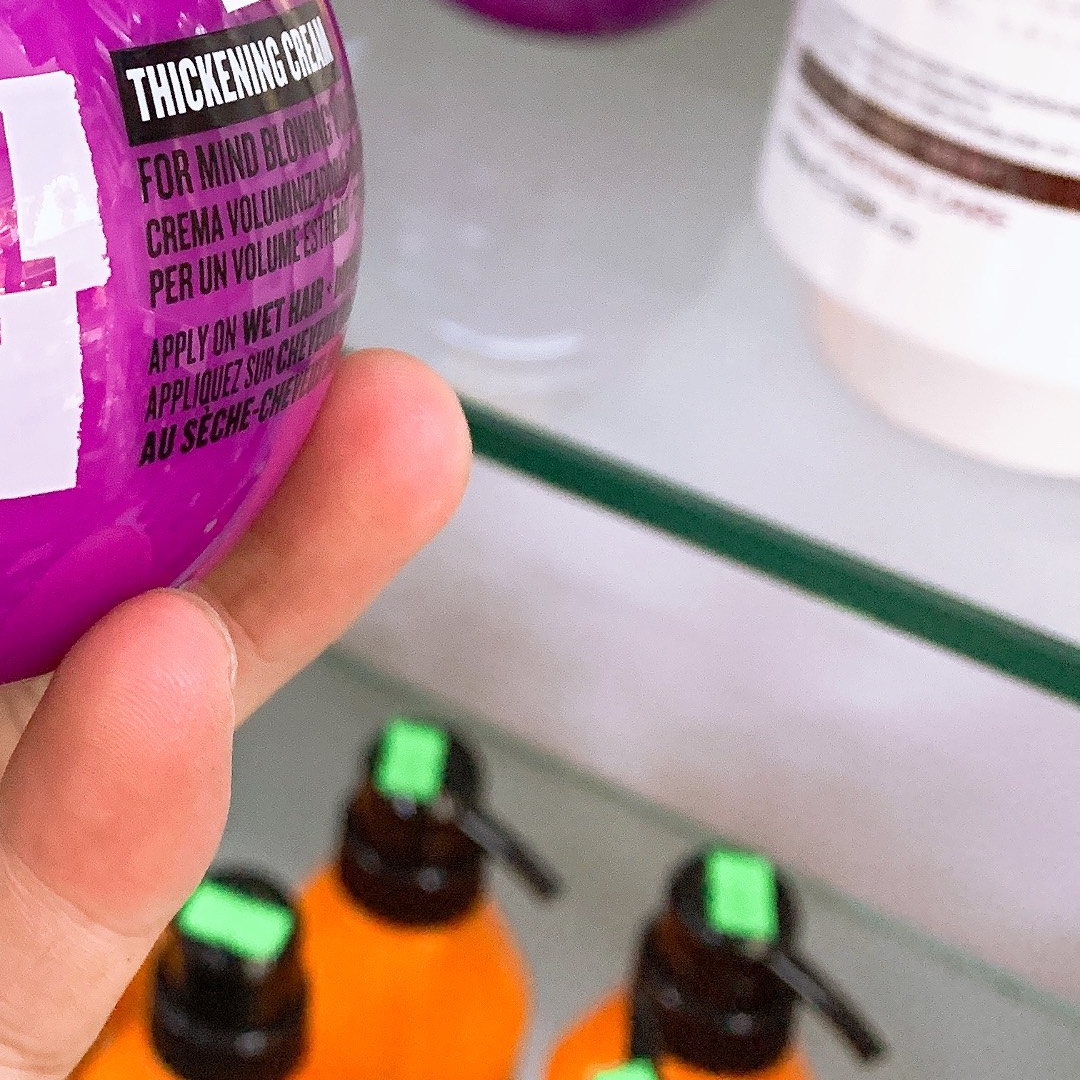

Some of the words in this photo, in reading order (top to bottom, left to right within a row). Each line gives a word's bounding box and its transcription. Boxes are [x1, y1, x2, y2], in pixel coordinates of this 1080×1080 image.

[126, 37, 288, 122] THICKENING
[281, 16, 335, 82] CREAM
[137, 149, 194, 204] FOR
[195, 132, 260, 191] MIND
[260, 104, 334, 171] BLOWING
[146, 204, 225, 259] CREMA
[149, 262, 194, 308] PER
[199, 251, 227, 295] UN
[232, 225, 301, 284] VOLUME
[147, 324, 209, 376] APPLY
[213, 315, 237, 356] ON
[242, 297, 286, 346] WET
[288, 277, 324, 327] HAIR
[144, 359, 243, 423] APPLIQUEZ
[244, 346, 274, 389] SUR
[139, 424, 178, 467] AU
